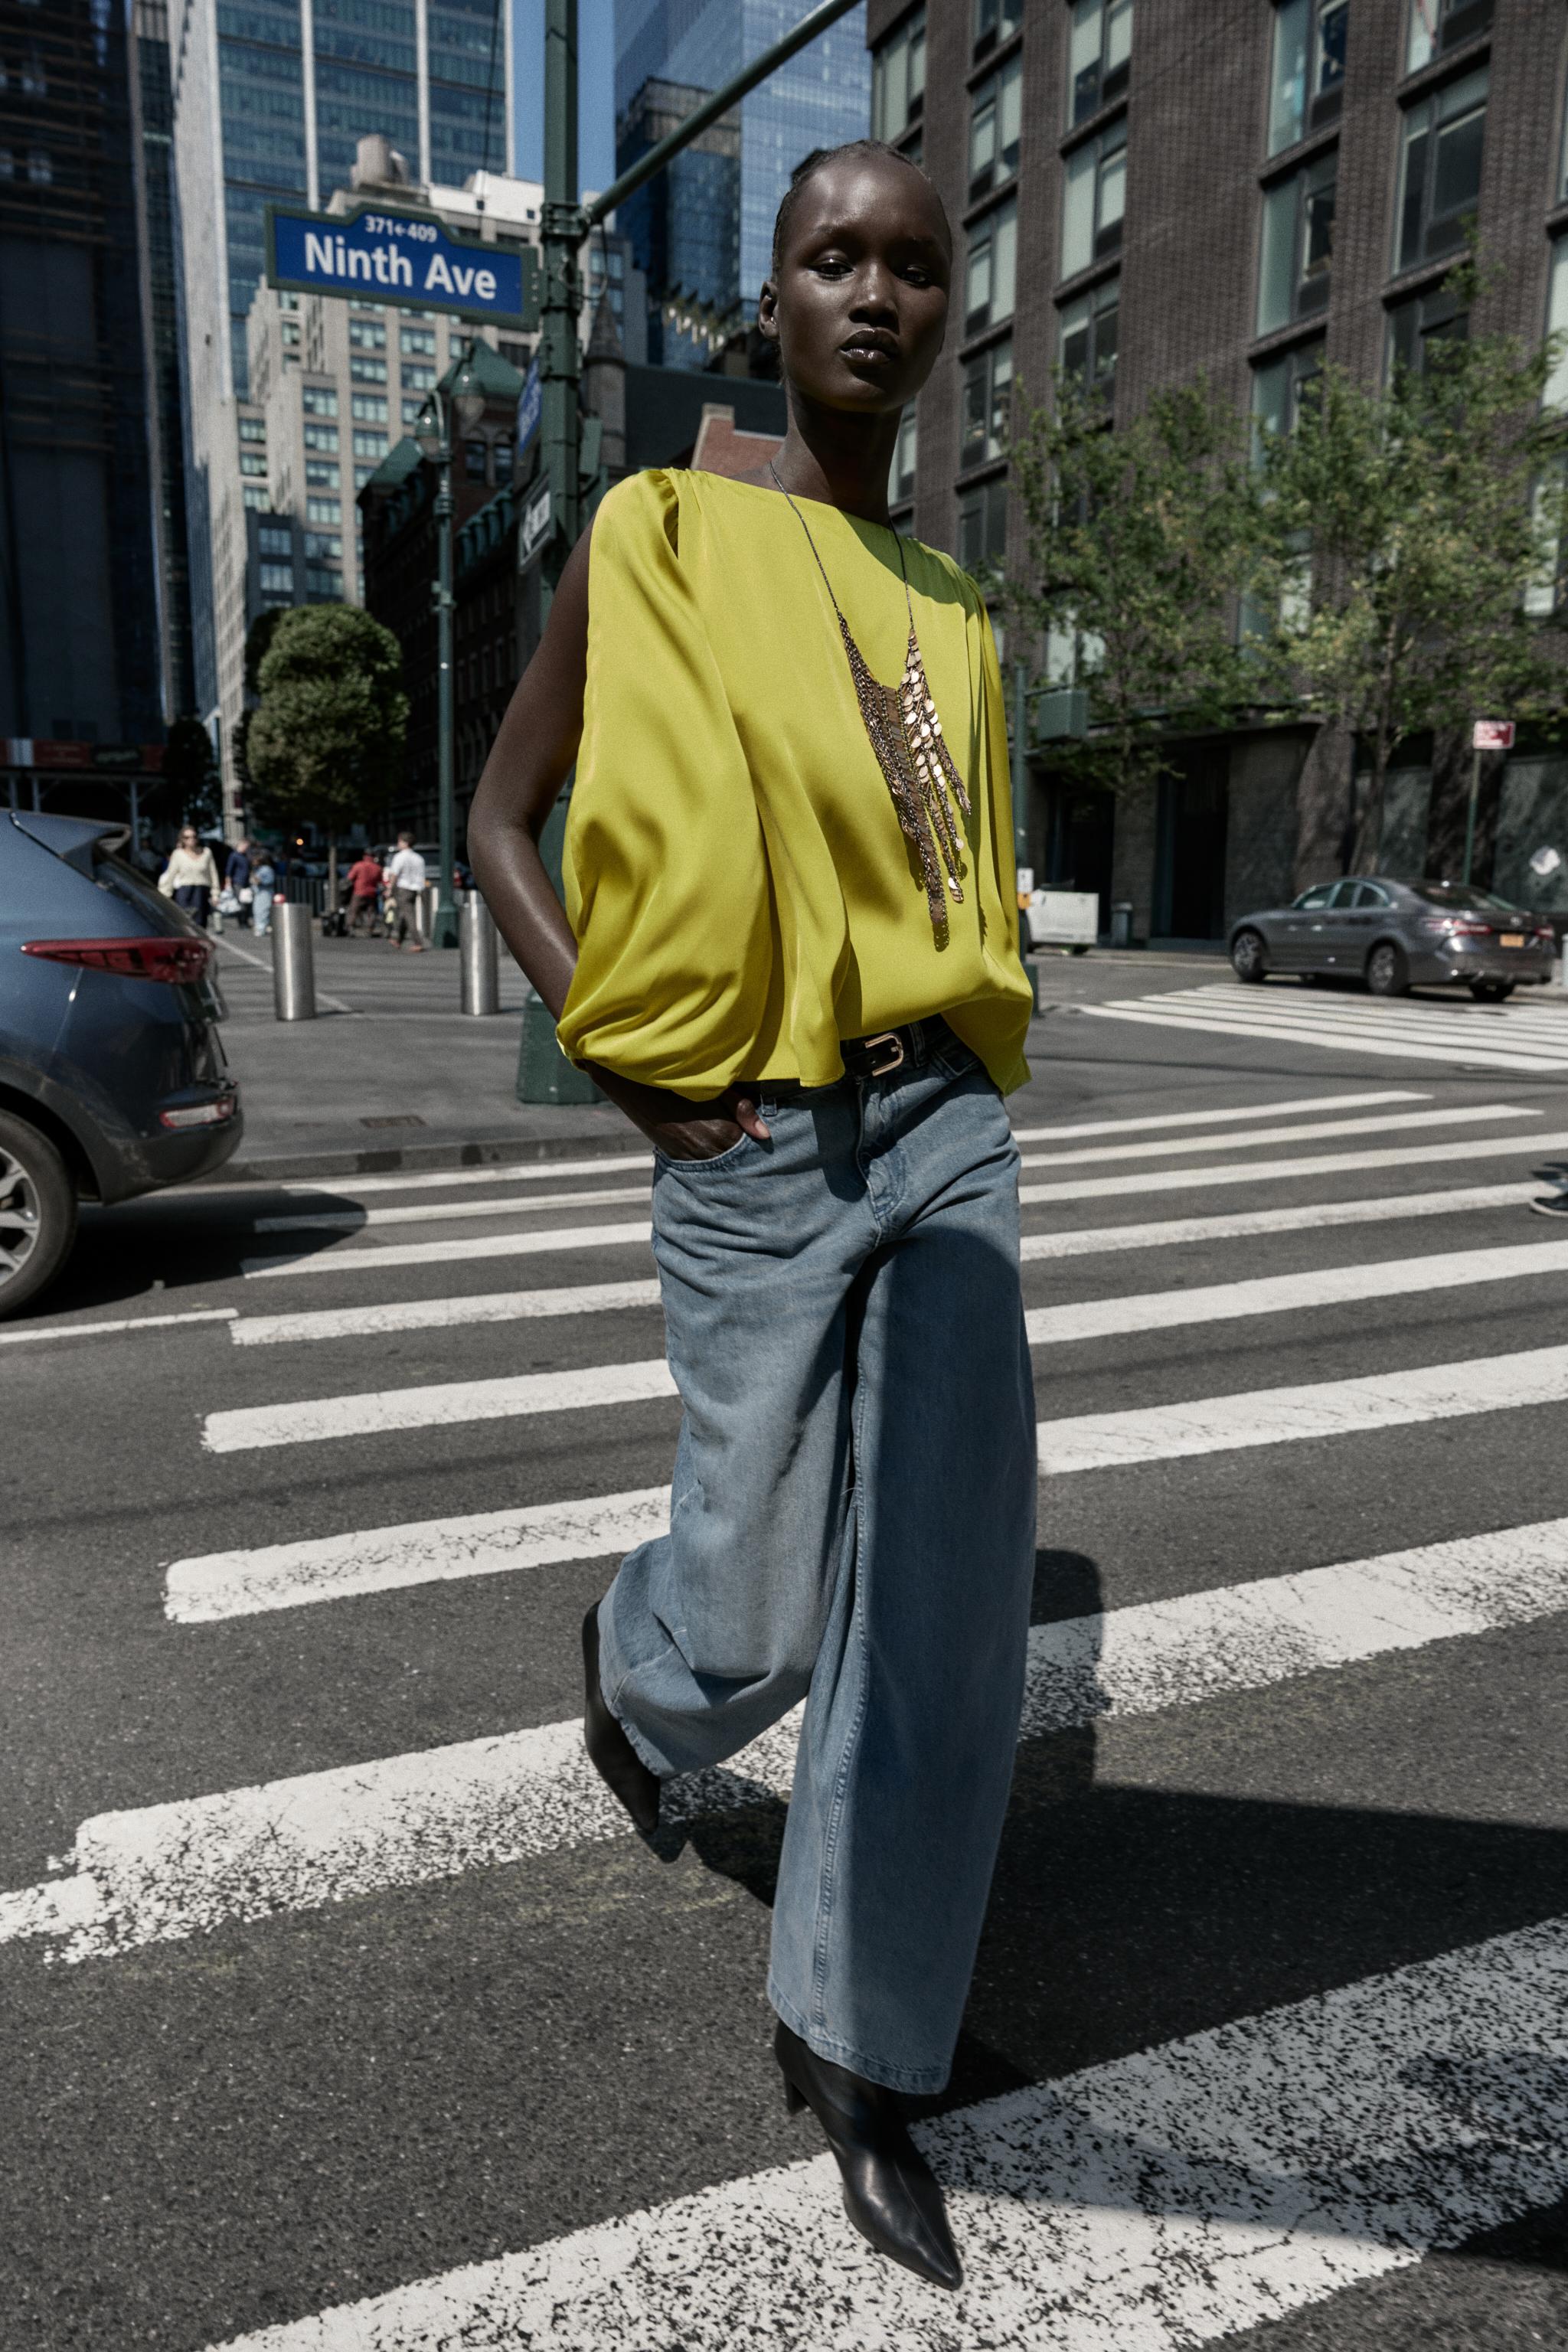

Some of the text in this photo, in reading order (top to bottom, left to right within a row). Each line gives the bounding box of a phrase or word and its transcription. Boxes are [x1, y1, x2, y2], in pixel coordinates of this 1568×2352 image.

[366, 215, 438, 243] 371 409
[305, 232, 497, 300] Ninth Ave
